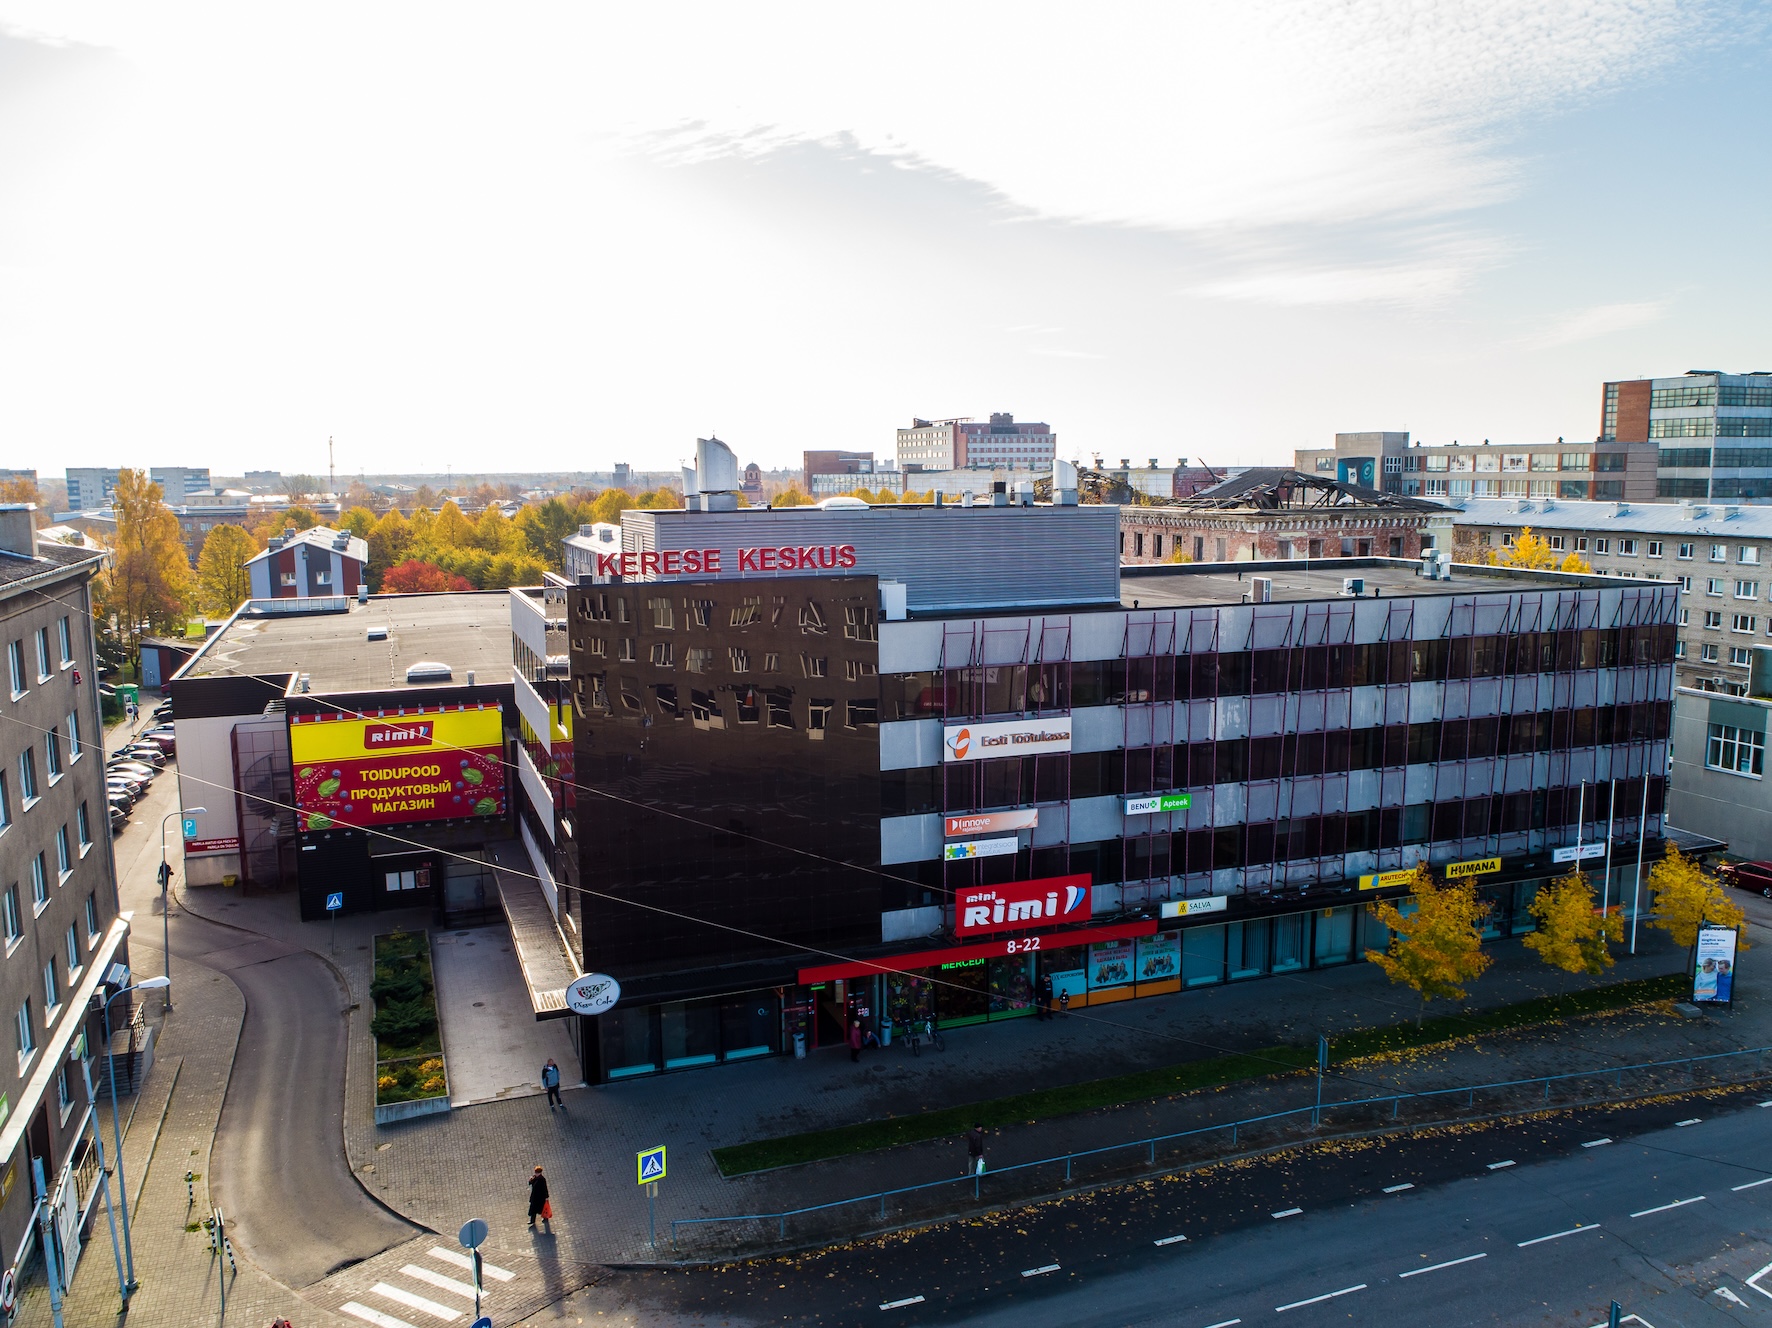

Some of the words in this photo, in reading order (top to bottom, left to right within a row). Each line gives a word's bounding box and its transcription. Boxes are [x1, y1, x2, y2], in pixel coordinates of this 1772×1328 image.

[597, 549, 721, 577] KERESE
[737, 544, 857, 571] KESKUS
[371, 728, 416, 743] Rimi
[981, 734, 1008, 747] Eesti
[1009, 730, 1070, 745] Töötukassa
[359, 764, 441, 782] TOIDUPOOD
[351, 779, 452, 801] ПРОДУКТОВЫЙ
[372, 798, 435, 813] МАГАЗИН
[1130, 802, 1150, 811] BENU
[1163, 798, 1188, 808] Apteek
[186, 821, 192, 829] P
[962, 817, 991, 828] innove
[1450, 861, 1496, 876] HUMANA
[966, 891, 996, 903] mini
[964, 892, 1058, 927] Rimi
[1189, 901, 1212, 910] SALVA
[1007, 937, 1040, 954] 8-22
[573, 1001, 593, 1009] Pizza
